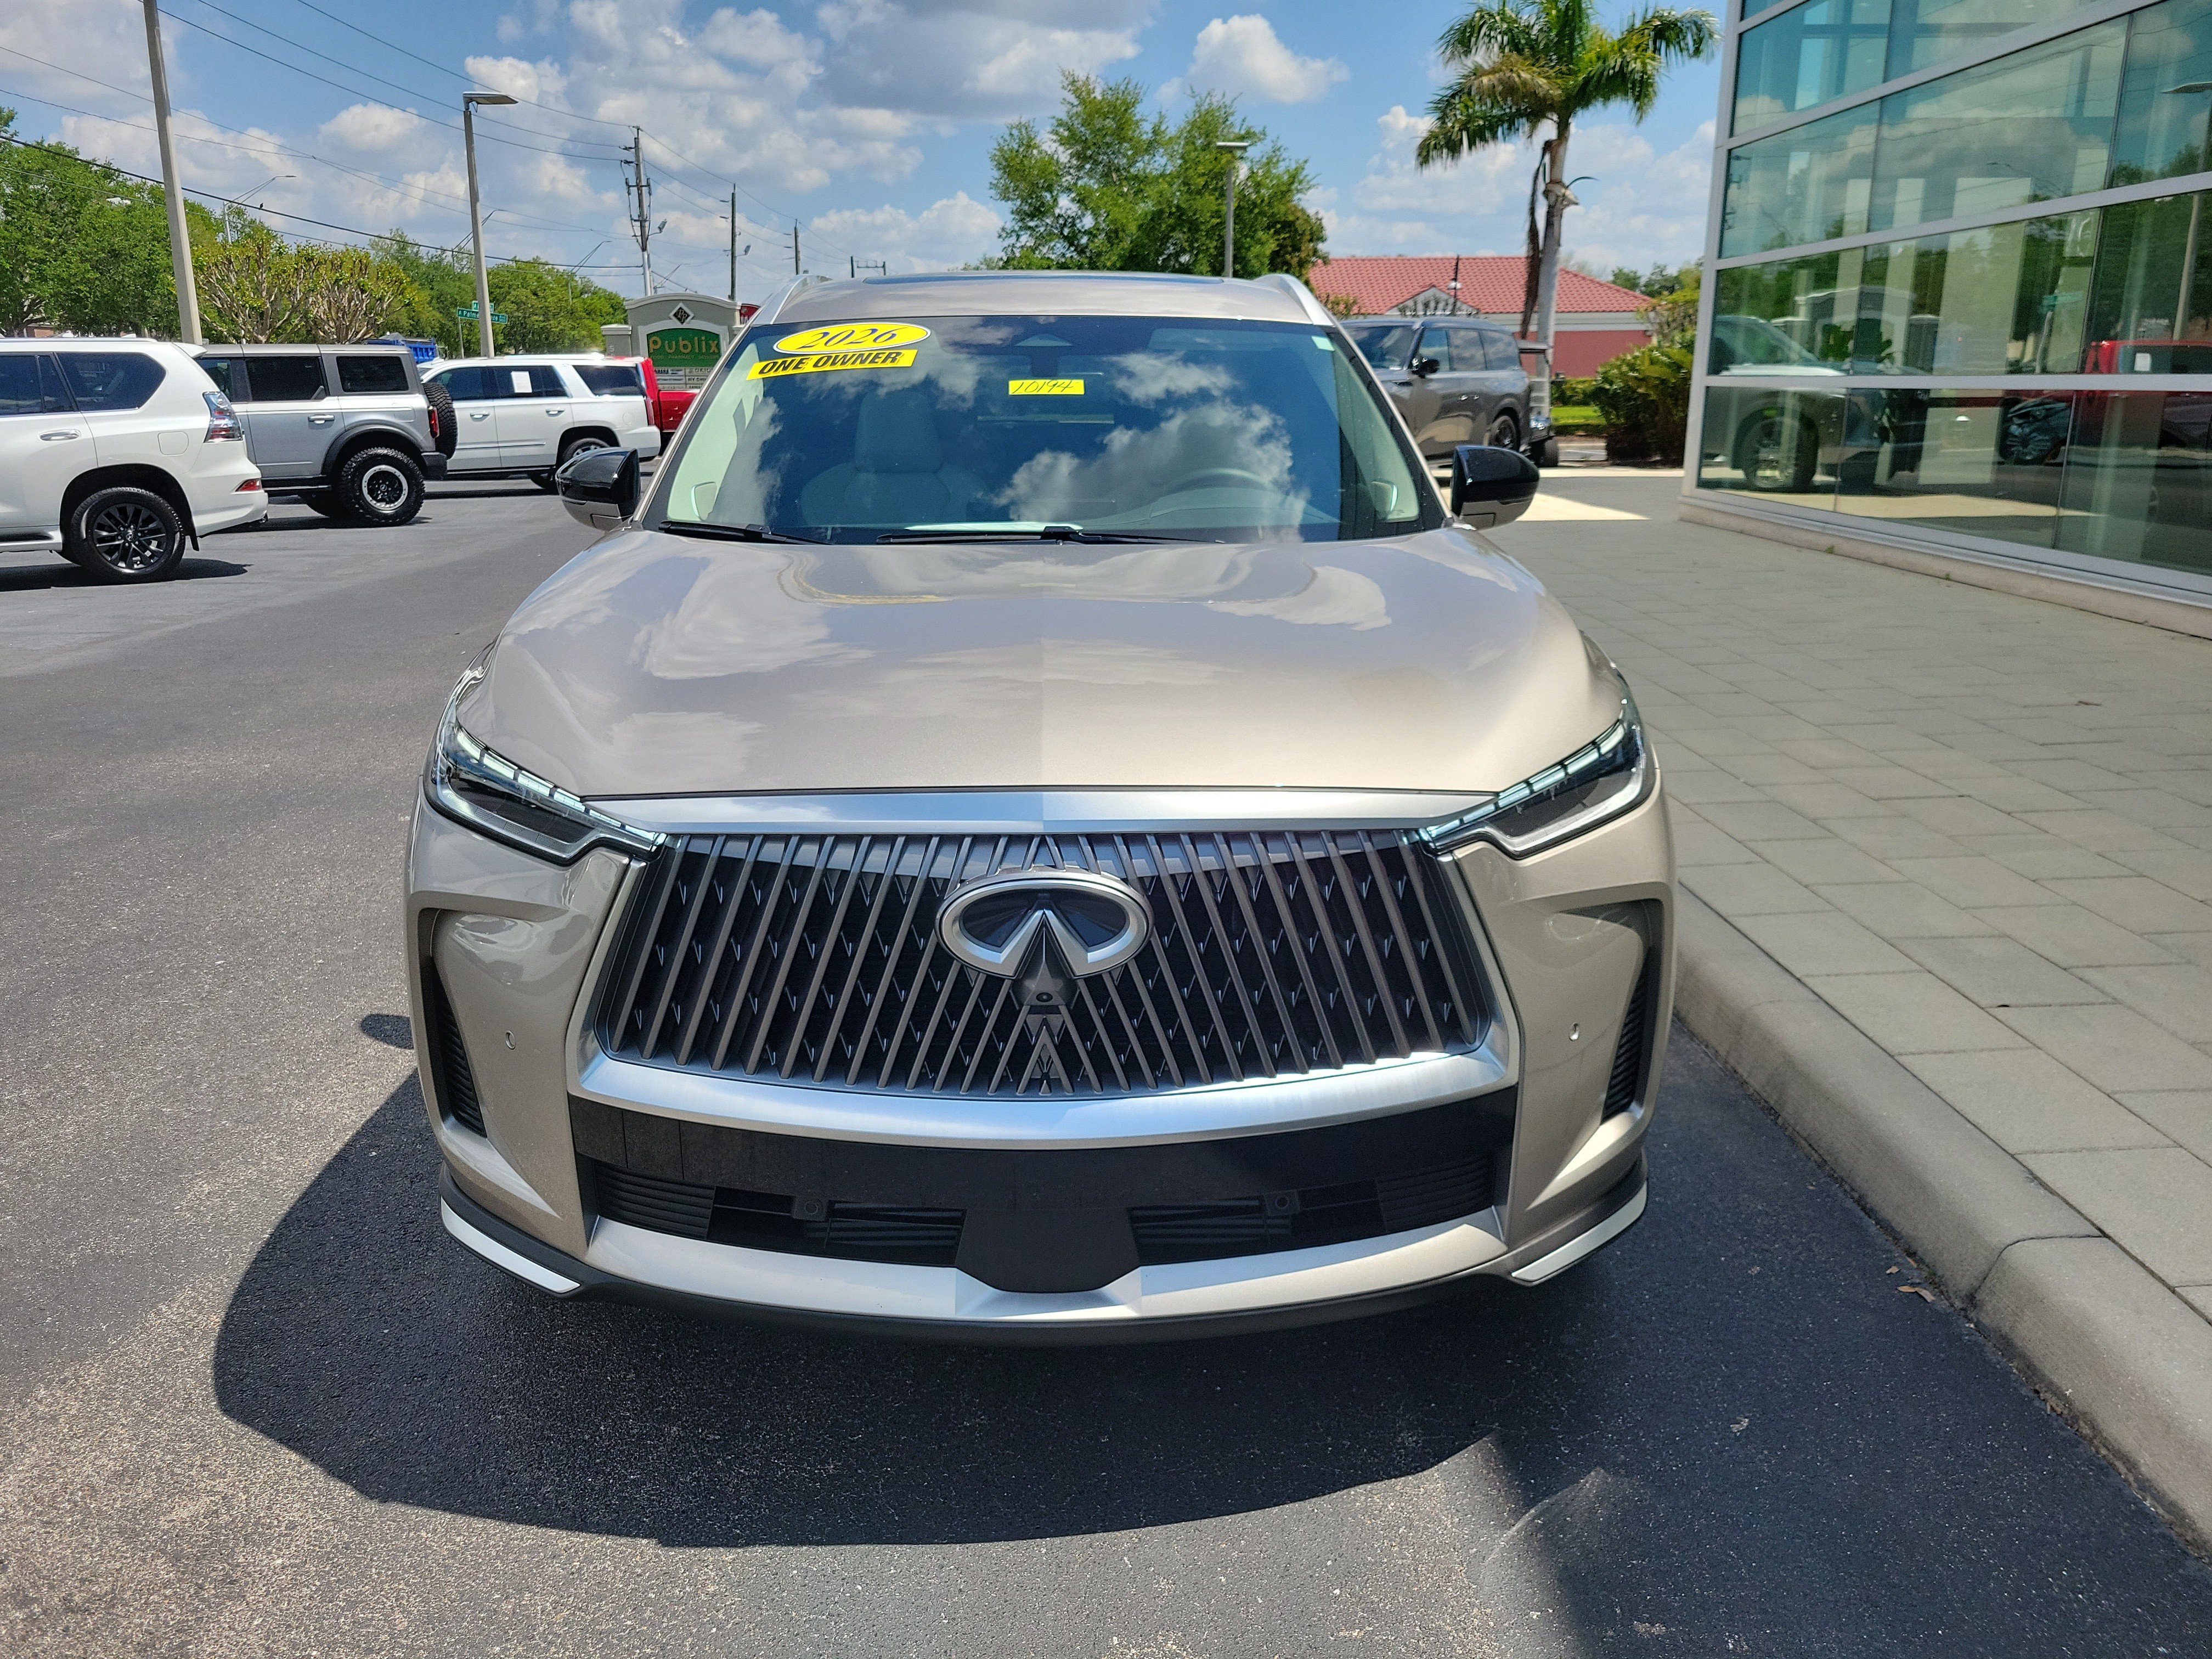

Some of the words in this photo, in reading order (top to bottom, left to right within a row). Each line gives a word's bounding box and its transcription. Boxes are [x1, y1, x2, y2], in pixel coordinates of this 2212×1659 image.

[649, 336, 718, 353] Publix
[795, 328, 907, 349] 2026
[758, 357, 809, 375] ONE
[812, 352, 904, 368] OWNER
